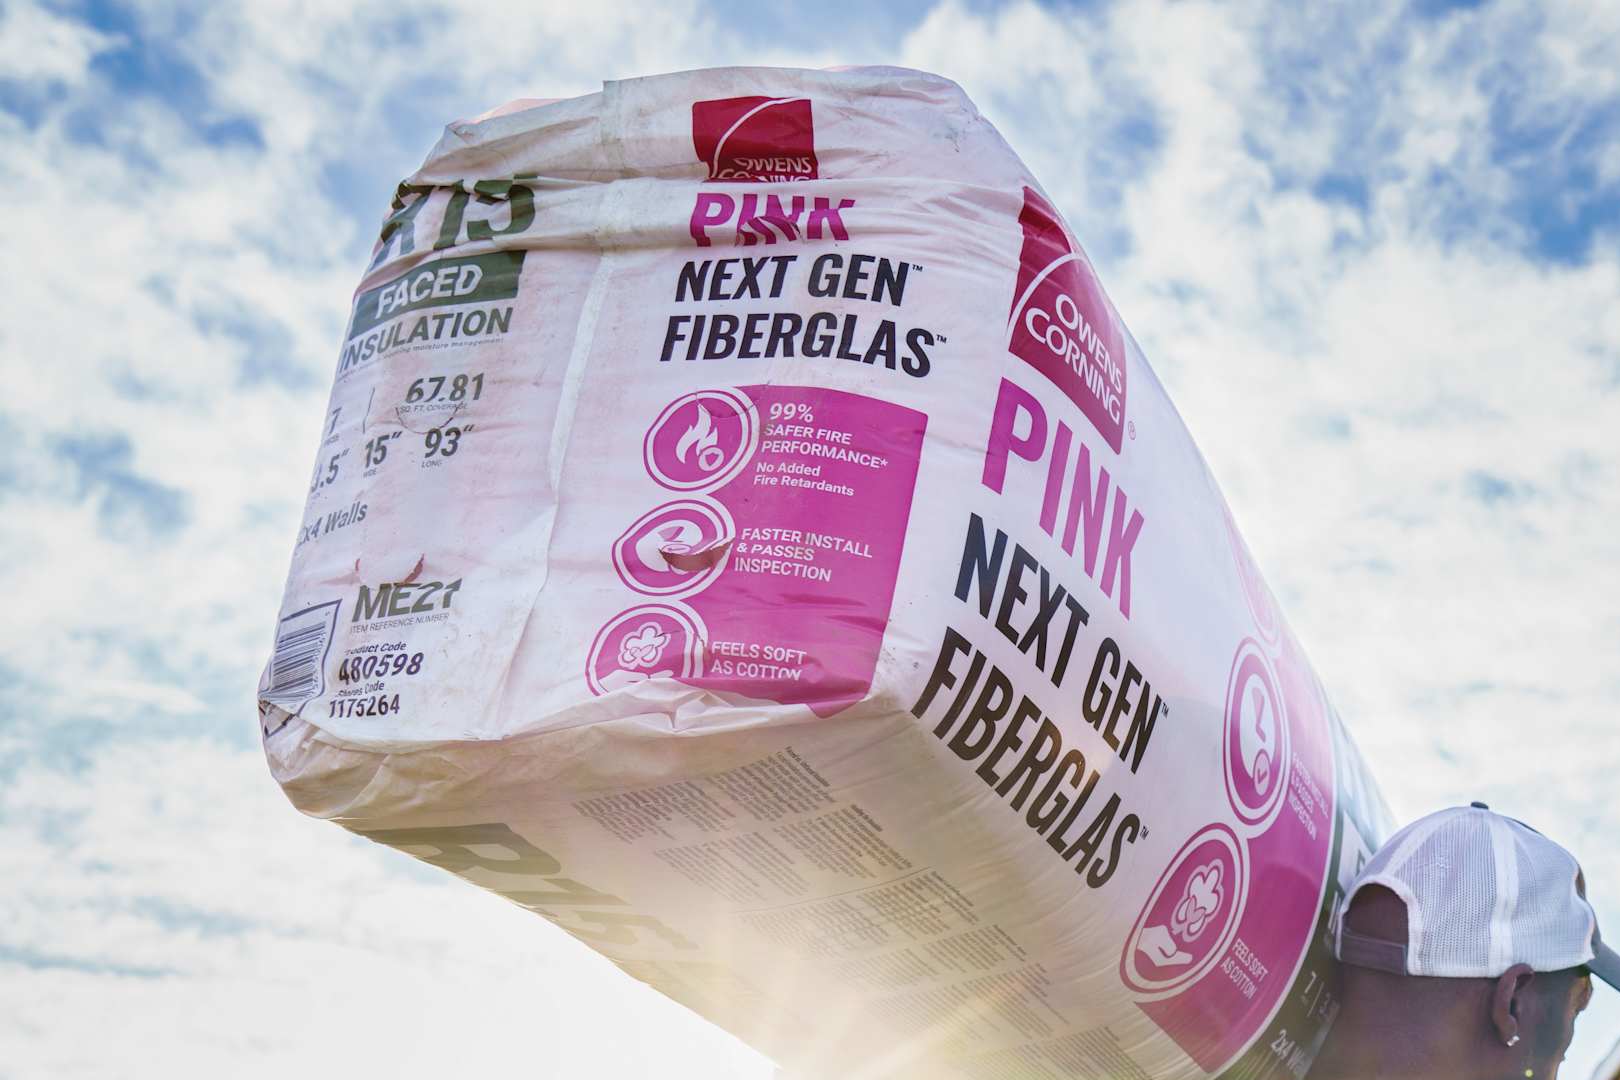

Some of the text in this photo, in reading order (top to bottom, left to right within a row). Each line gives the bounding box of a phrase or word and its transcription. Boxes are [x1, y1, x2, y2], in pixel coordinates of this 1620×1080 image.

[690, 192, 855, 247] PINK
[376, 264, 483, 320] FACED
[675, 255, 798, 302] NEXT
[339, 307, 513, 374] INSULATION
[1055, 293, 1123, 396] OWENS
[1025, 307, 1121, 425] CORNING
[405, 372, 485, 404] 67.81
[769, 402, 814, 424] 99%
[764, 424, 853, 445] SAFER FIRE
[756, 461, 821, 477] No Added
[753, 475, 855, 497] Fire Retardants
[982, 377, 1145, 622] PINK
[325, 501, 368, 534] Walls
[736, 543, 814, 561] & PASSES
[741, 528, 872, 558] FASTER INSTALL
[734, 557, 832, 582] INSPECTION
[352, 578, 462, 623] ME21
[954, 512, 1089, 688] NEXT
[350, 612, 450, 634] ITEM REFERENCE NUMBER
[380, 641, 407, 652] Code
[711, 641, 807, 664] FEELS SOFT
[339, 652, 424, 685] 480598
[710, 659, 802, 681] AS COTTON
[364, 680, 385, 695] Code
[329, 694, 400, 718] 1175264
[1232, 938, 1268, 981] FEELS SOFT
[1220, 957, 1257, 1000] AS COTTON
